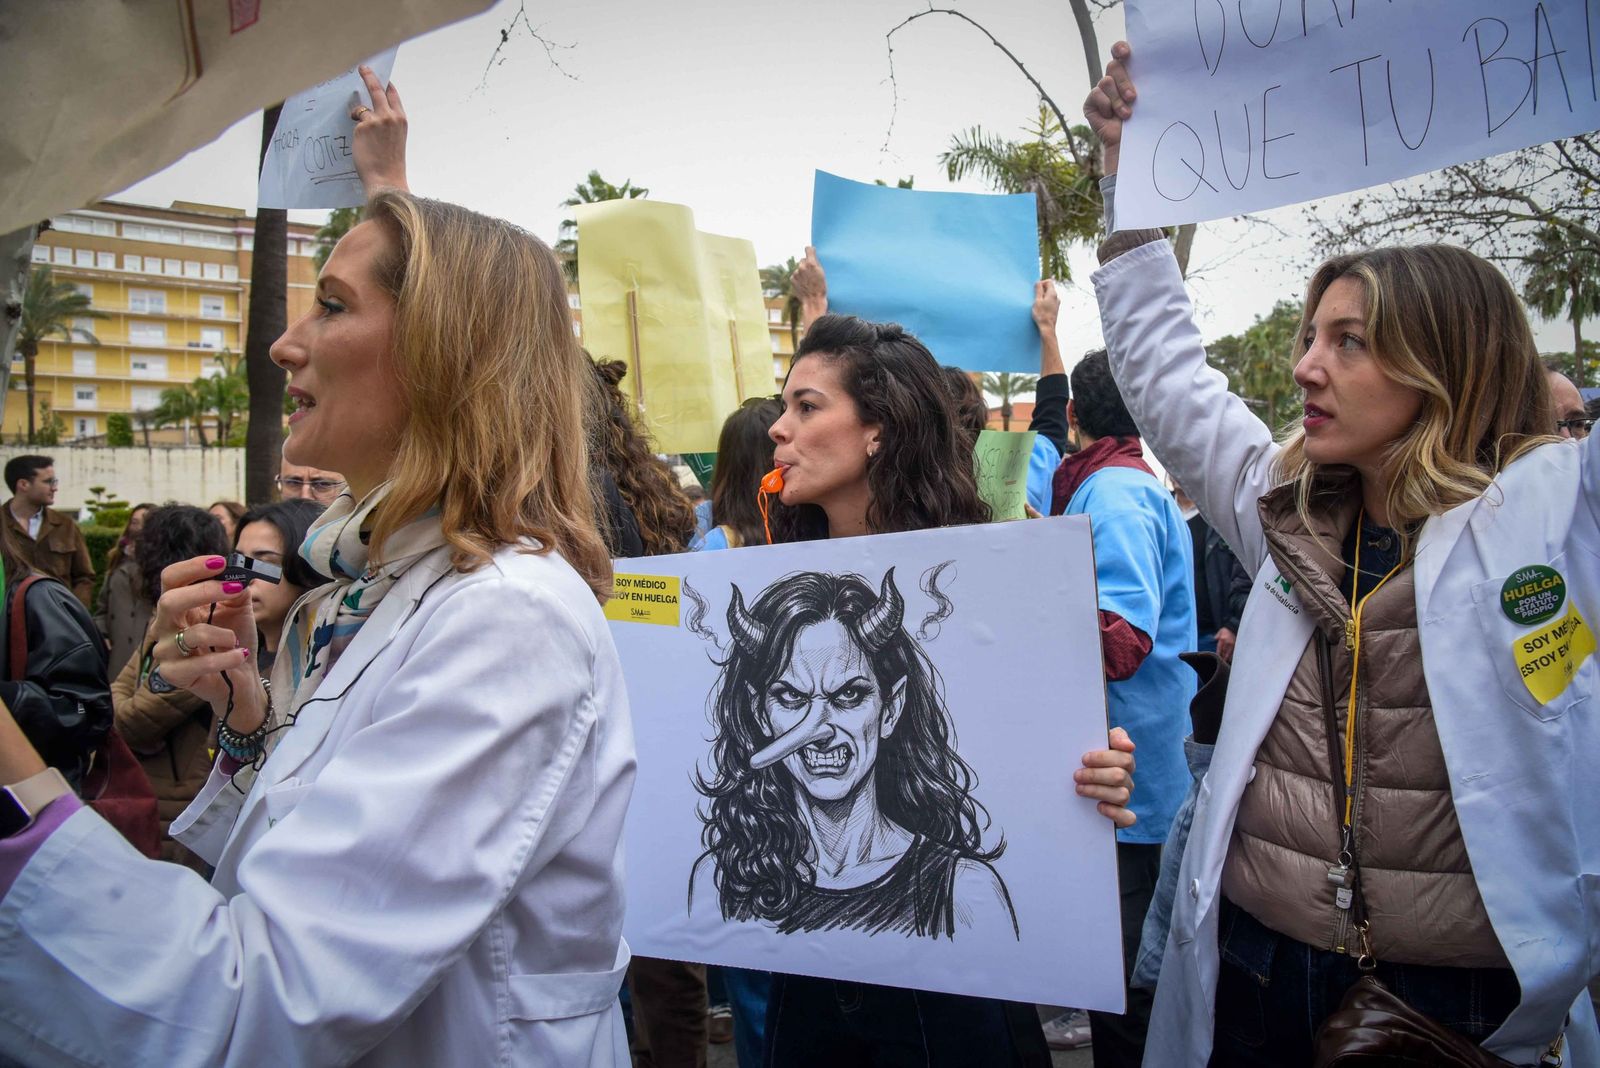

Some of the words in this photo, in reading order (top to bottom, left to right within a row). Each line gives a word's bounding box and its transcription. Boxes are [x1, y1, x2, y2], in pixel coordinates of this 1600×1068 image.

[1152, 84, 1301, 202] QUE
[1329, 47, 1435, 167] TU
[615, 578, 632, 588] SOY
[633, 578, 667, 590] MÉDICO
[1504, 575, 1562, 602] HUELGA
[631, 592, 643, 602] EN
[644, 593, 678, 604] HUELGA
[1514, 595, 1559, 615] ESTATUTO
[1518, 595, 1538, 606] POR
[1539, 591, 1552, 600] UN
[1521, 603, 1554, 618] PROPIO
[1523, 633, 1551, 654] SOY
[1520, 651, 1557, 678] ESTOY
